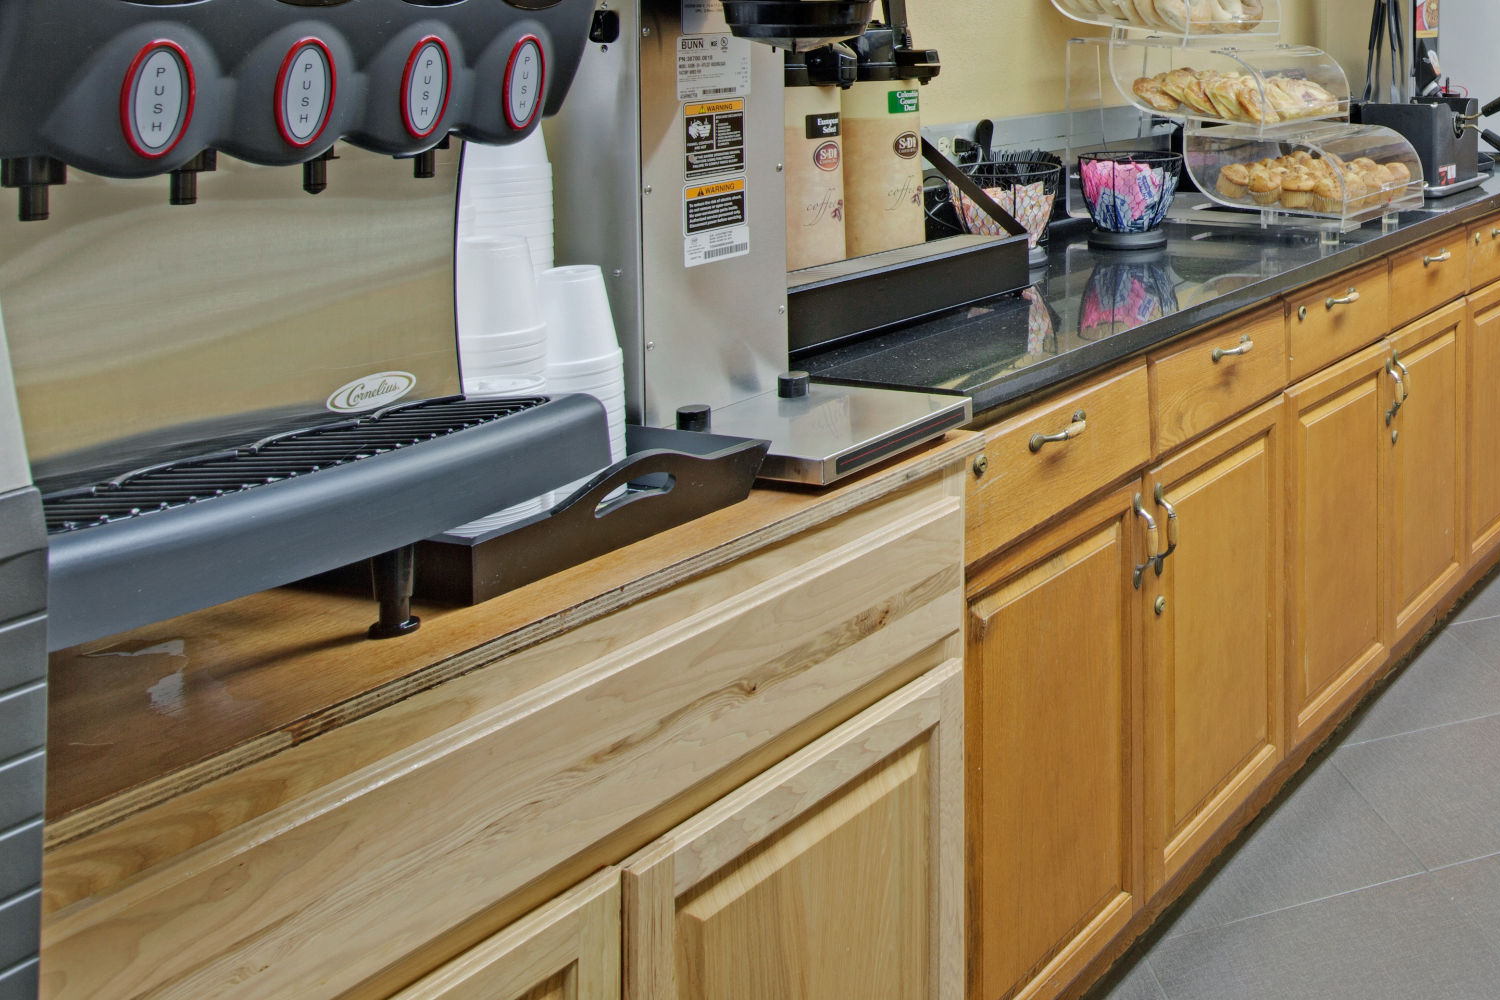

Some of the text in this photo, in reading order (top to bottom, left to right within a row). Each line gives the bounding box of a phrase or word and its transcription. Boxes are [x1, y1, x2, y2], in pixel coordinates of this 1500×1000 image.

[681, 40, 704, 50] BUNN
[151, 66, 167, 133] PUSH
[300, 62, 313, 124] PUSH
[420, 59, 434, 117] PUSH
[519, 55, 531, 109] PUSH
[706, 103, 733, 112] WARNING
[705, 182, 735, 194] WARNING
